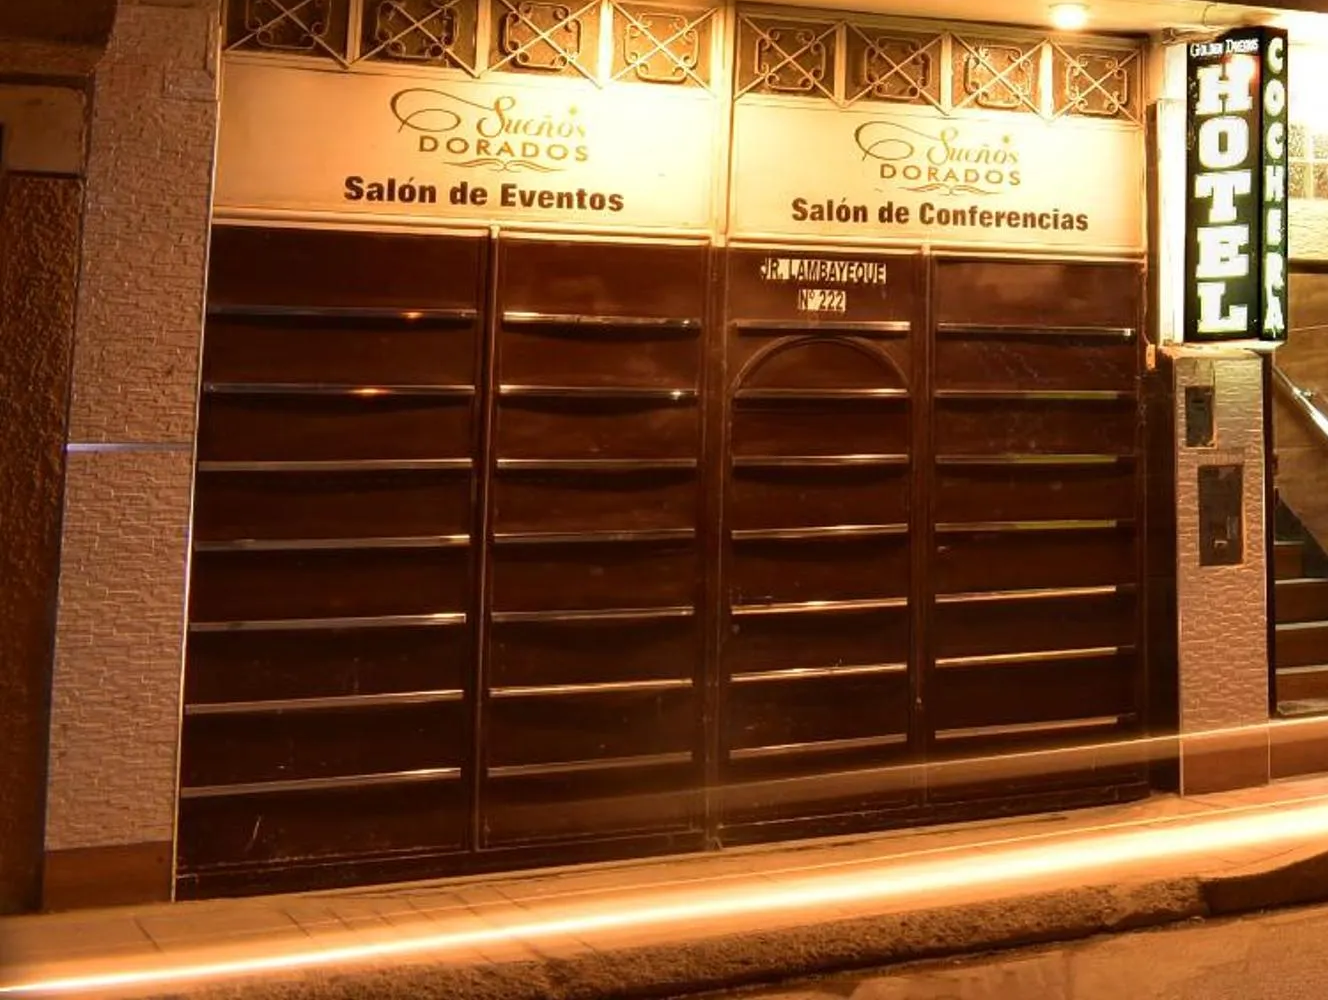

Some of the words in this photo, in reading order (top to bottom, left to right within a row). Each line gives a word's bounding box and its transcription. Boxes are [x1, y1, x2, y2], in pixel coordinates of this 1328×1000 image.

[390, 87, 587, 138] Sueños
[418, 135, 589, 163] DORADOS
[853, 120, 1020, 167] Sueños
[880, 164, 1022, 186] DORADOS
[344, 175, 437, 204] Salón
[449, 181, 488, 206] de
[500, 183, 625, 212] Eventos
[1194, 53, 1254, 334] HOTEL
[791, 197, 868, 223] Salón
[878, 201, 910, 224] de
[919, 202, 1090, 232] Conferencias
[761, 258, 784, 280] JR.
[788, 258, 886, 284] LAMBAYEQUE
[819, 290, 845, 312] 222
